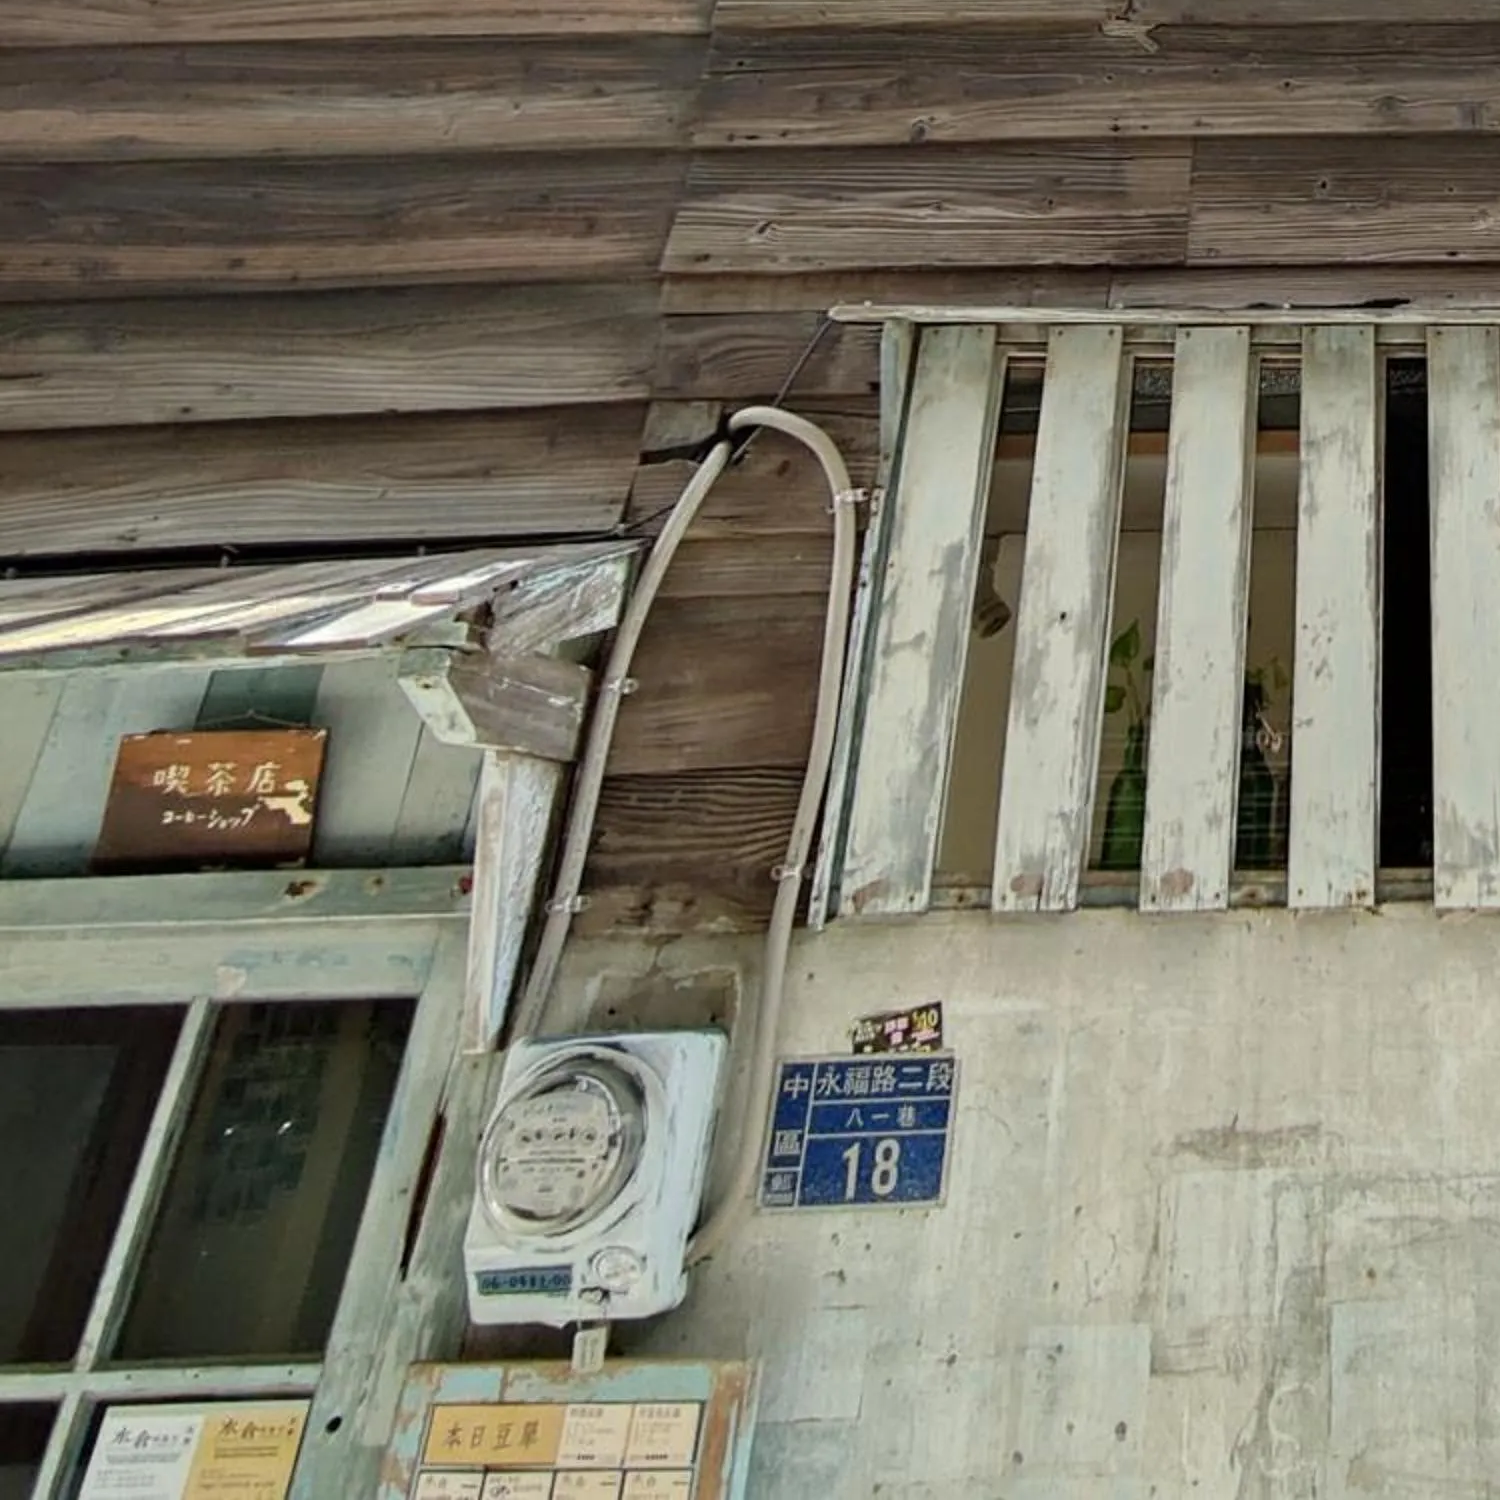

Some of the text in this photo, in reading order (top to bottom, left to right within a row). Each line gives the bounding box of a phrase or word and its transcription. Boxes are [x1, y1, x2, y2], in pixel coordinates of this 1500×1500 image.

[153, 761, 281, 797] 喫茶店
[816, 1063, 951, 1096] 永福路二段
[842, 1138, 900, 1200] 18
